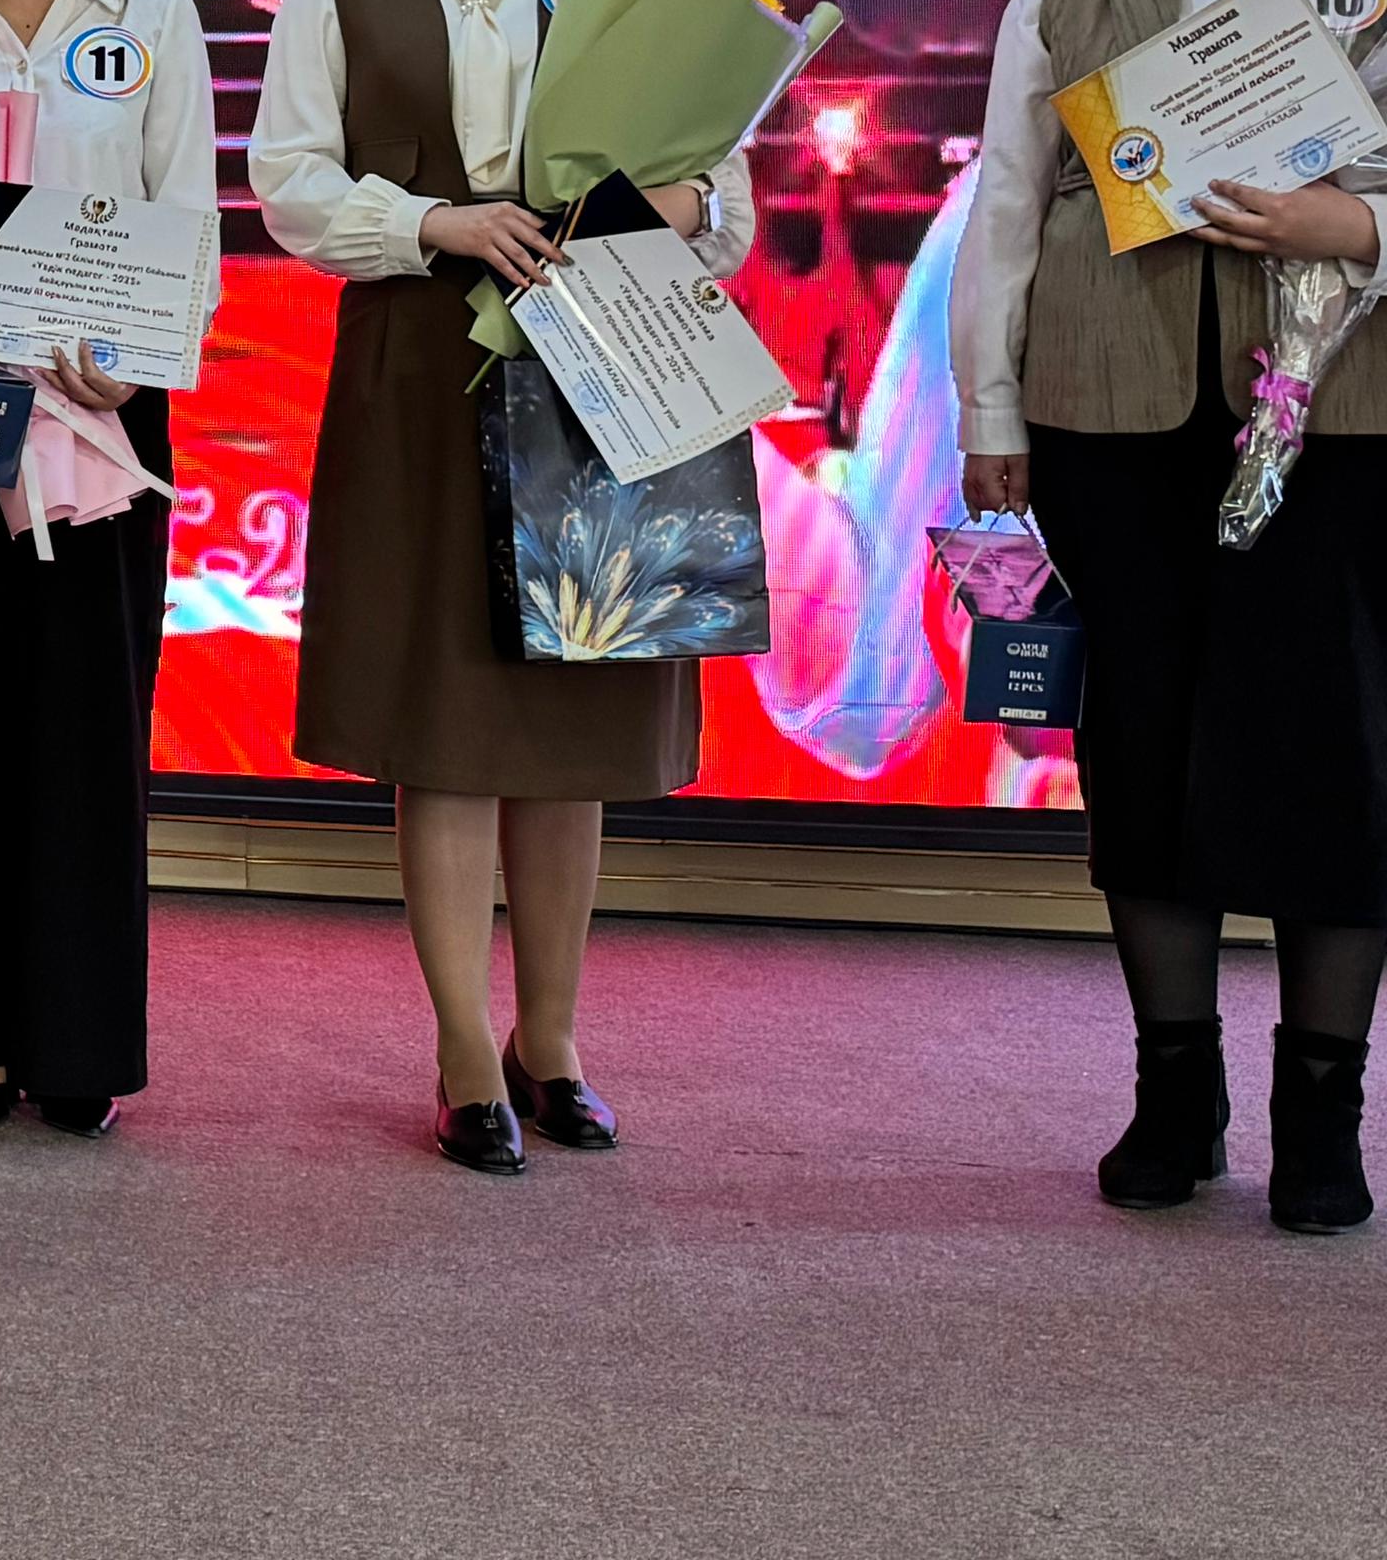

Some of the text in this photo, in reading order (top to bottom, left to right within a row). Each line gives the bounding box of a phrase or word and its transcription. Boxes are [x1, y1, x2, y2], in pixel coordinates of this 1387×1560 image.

[1188, 30, 1242, 65] Грамота
[89, 46, 125, 81] 11
[70, 237, 118, 253] Грамота
[663, 295, 696, 341] Грамота
[1008, 682, 1044, 692] 12 PCS
[1009, 670, 1045, 681] BOWL
